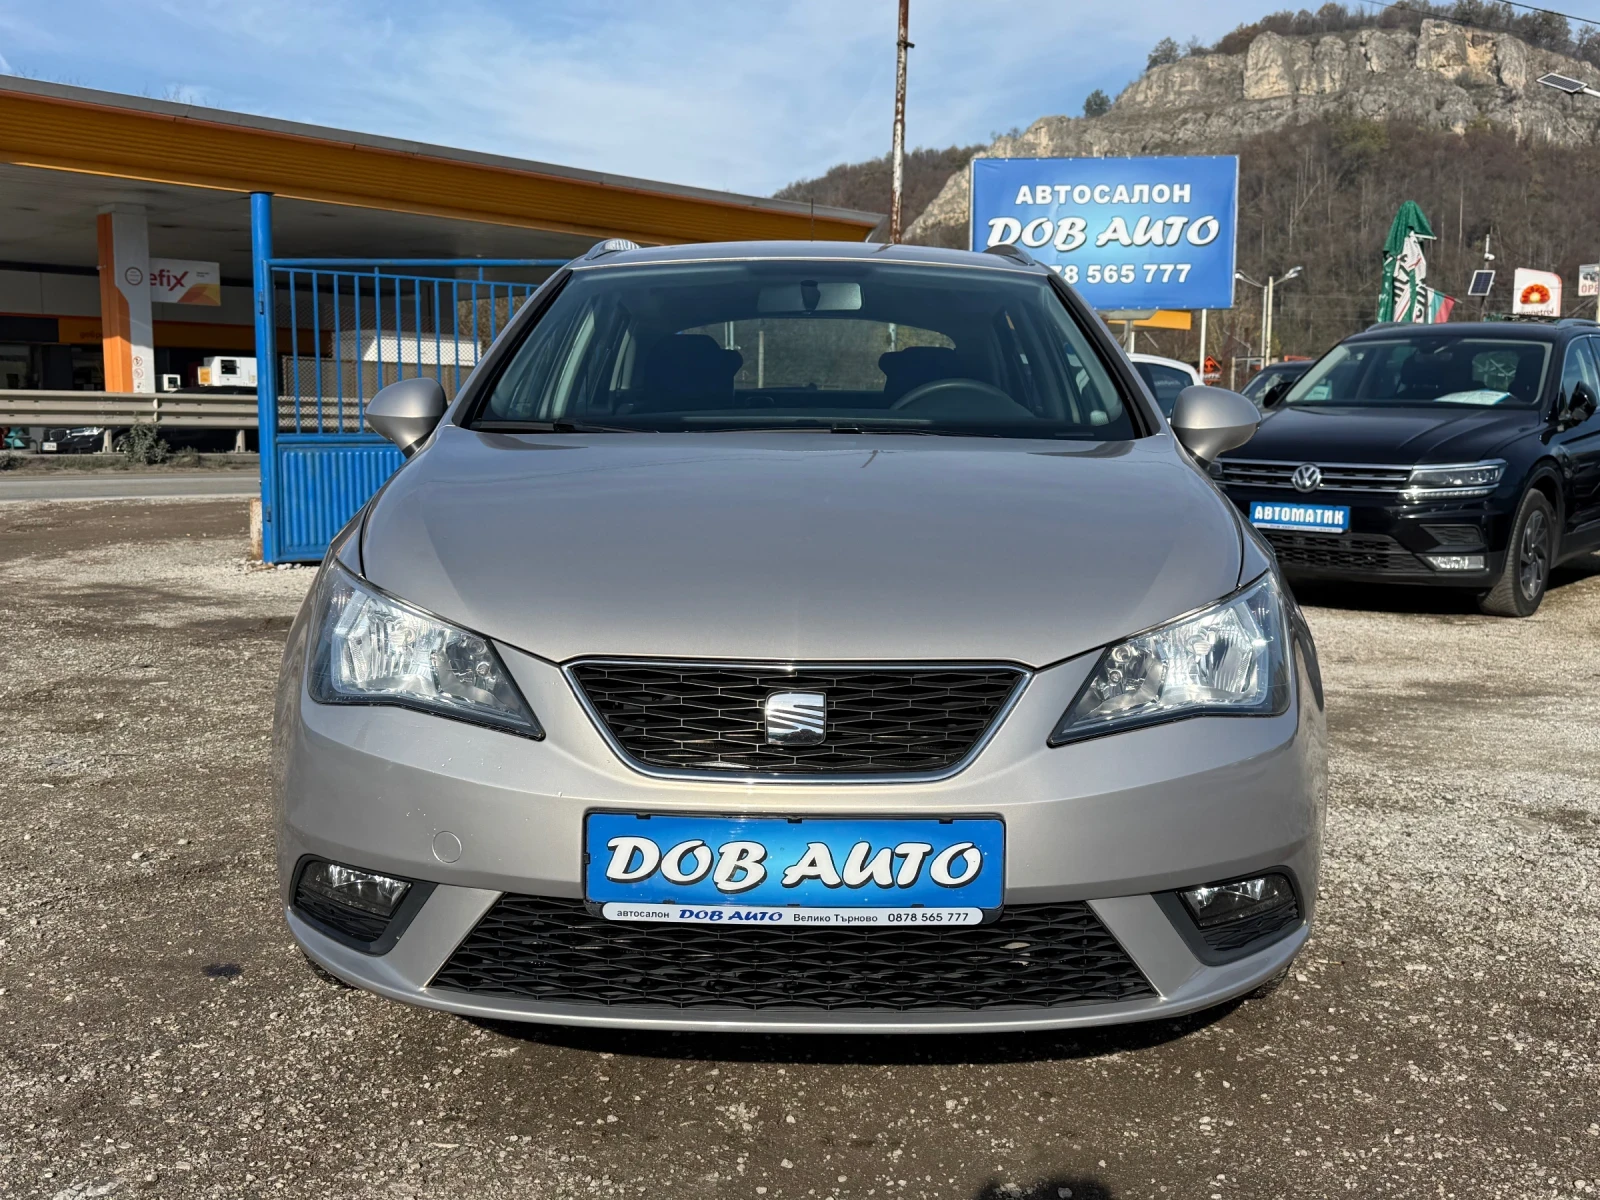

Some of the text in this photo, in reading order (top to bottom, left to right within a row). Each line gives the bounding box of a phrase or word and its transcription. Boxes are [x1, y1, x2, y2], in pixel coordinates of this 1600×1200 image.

[1014, 183, 1192, 205] АВТОСАЛОН
[986, 215, 1221, 252] DOB AUTO
[1086, 264, 1136, 284] 565
[1142, 263, 1193, 283] 777
[1255, 505, 1345, 525] АВТОМАТИК
[605, 835, 984, 893] DOB AUTO
[616, 909, 969, 924] автосалон DOB AUTO Велико Търново 0878 565 777
